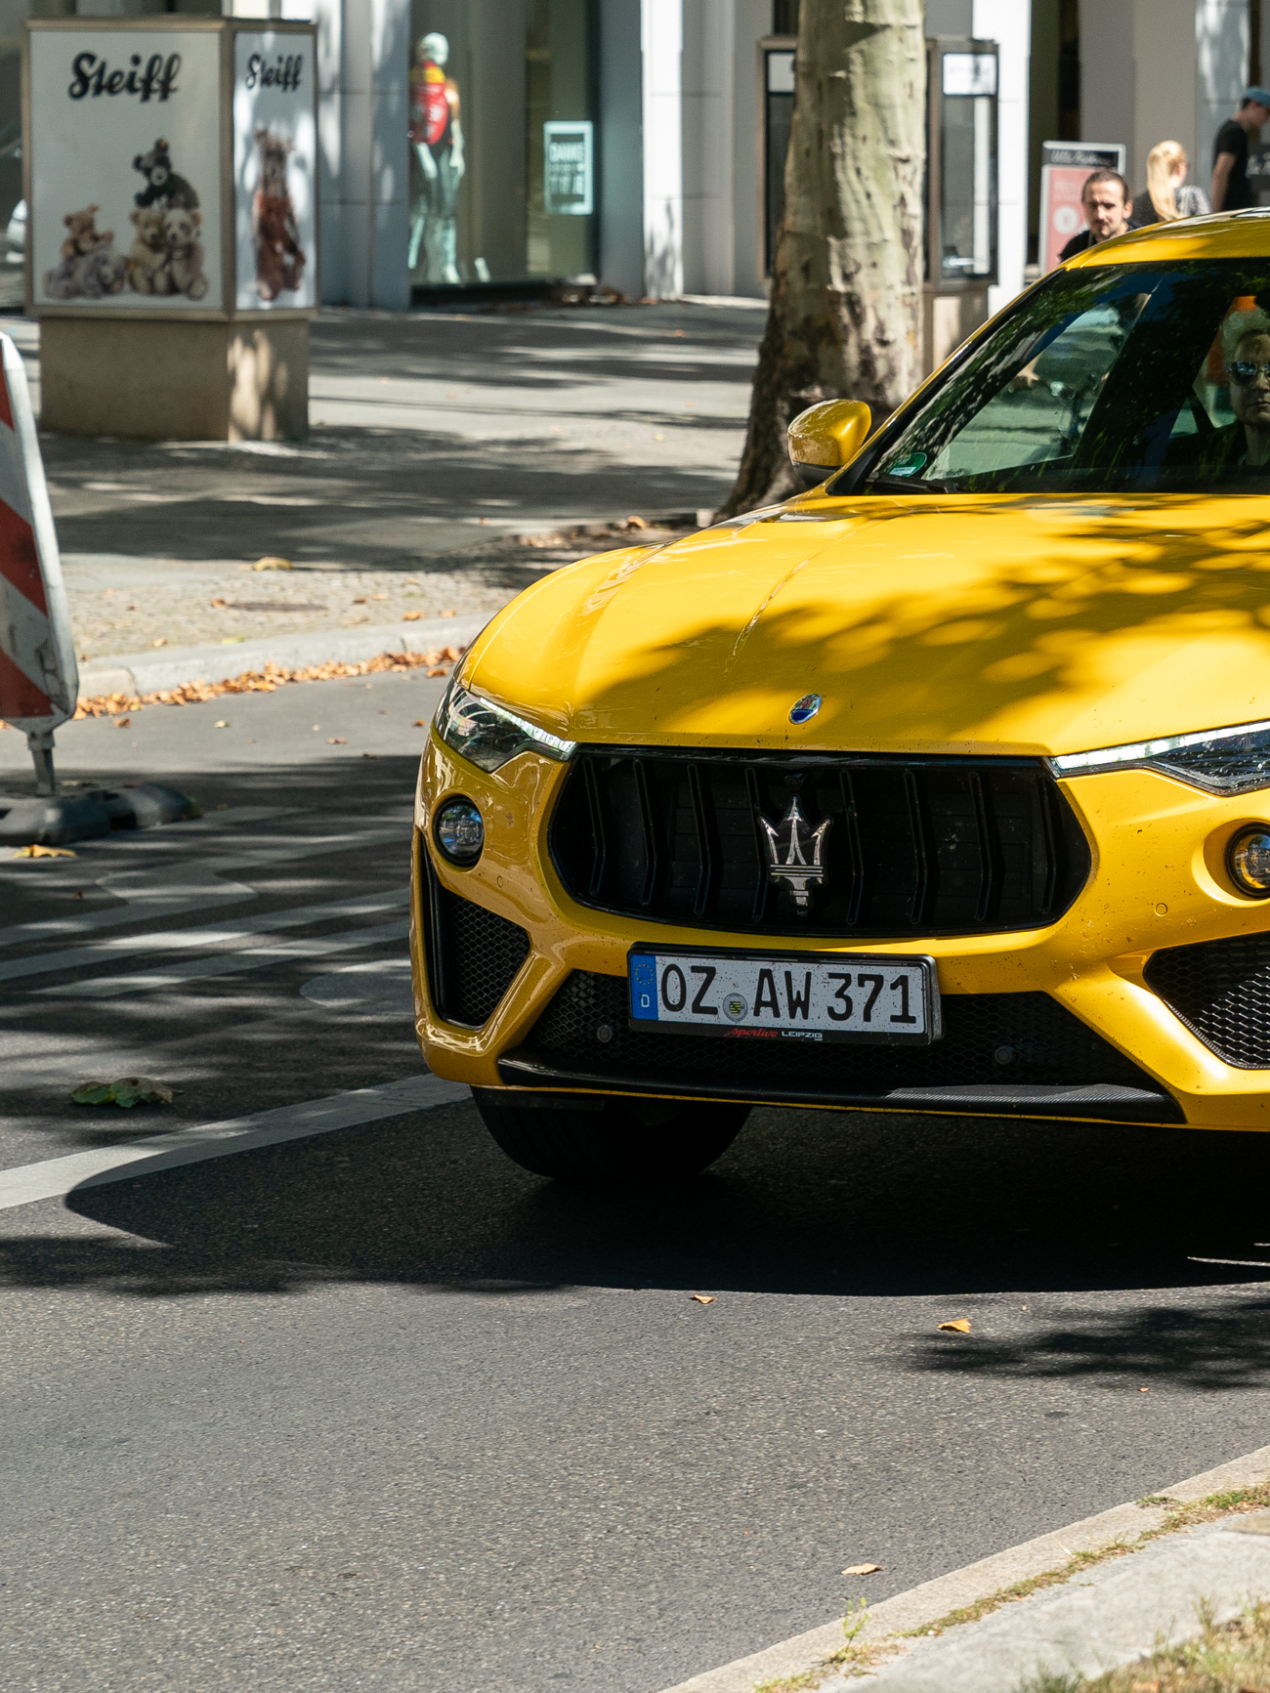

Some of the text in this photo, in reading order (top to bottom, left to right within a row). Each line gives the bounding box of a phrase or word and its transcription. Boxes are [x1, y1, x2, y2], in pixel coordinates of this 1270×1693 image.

[68, 52, 182, 104] Steiff
[245, 53, 303, 92] Steiff
[641, 963, 917, 1024] D OZ AW 371
[781, 1030, 823, 1038] LEIPZIG
